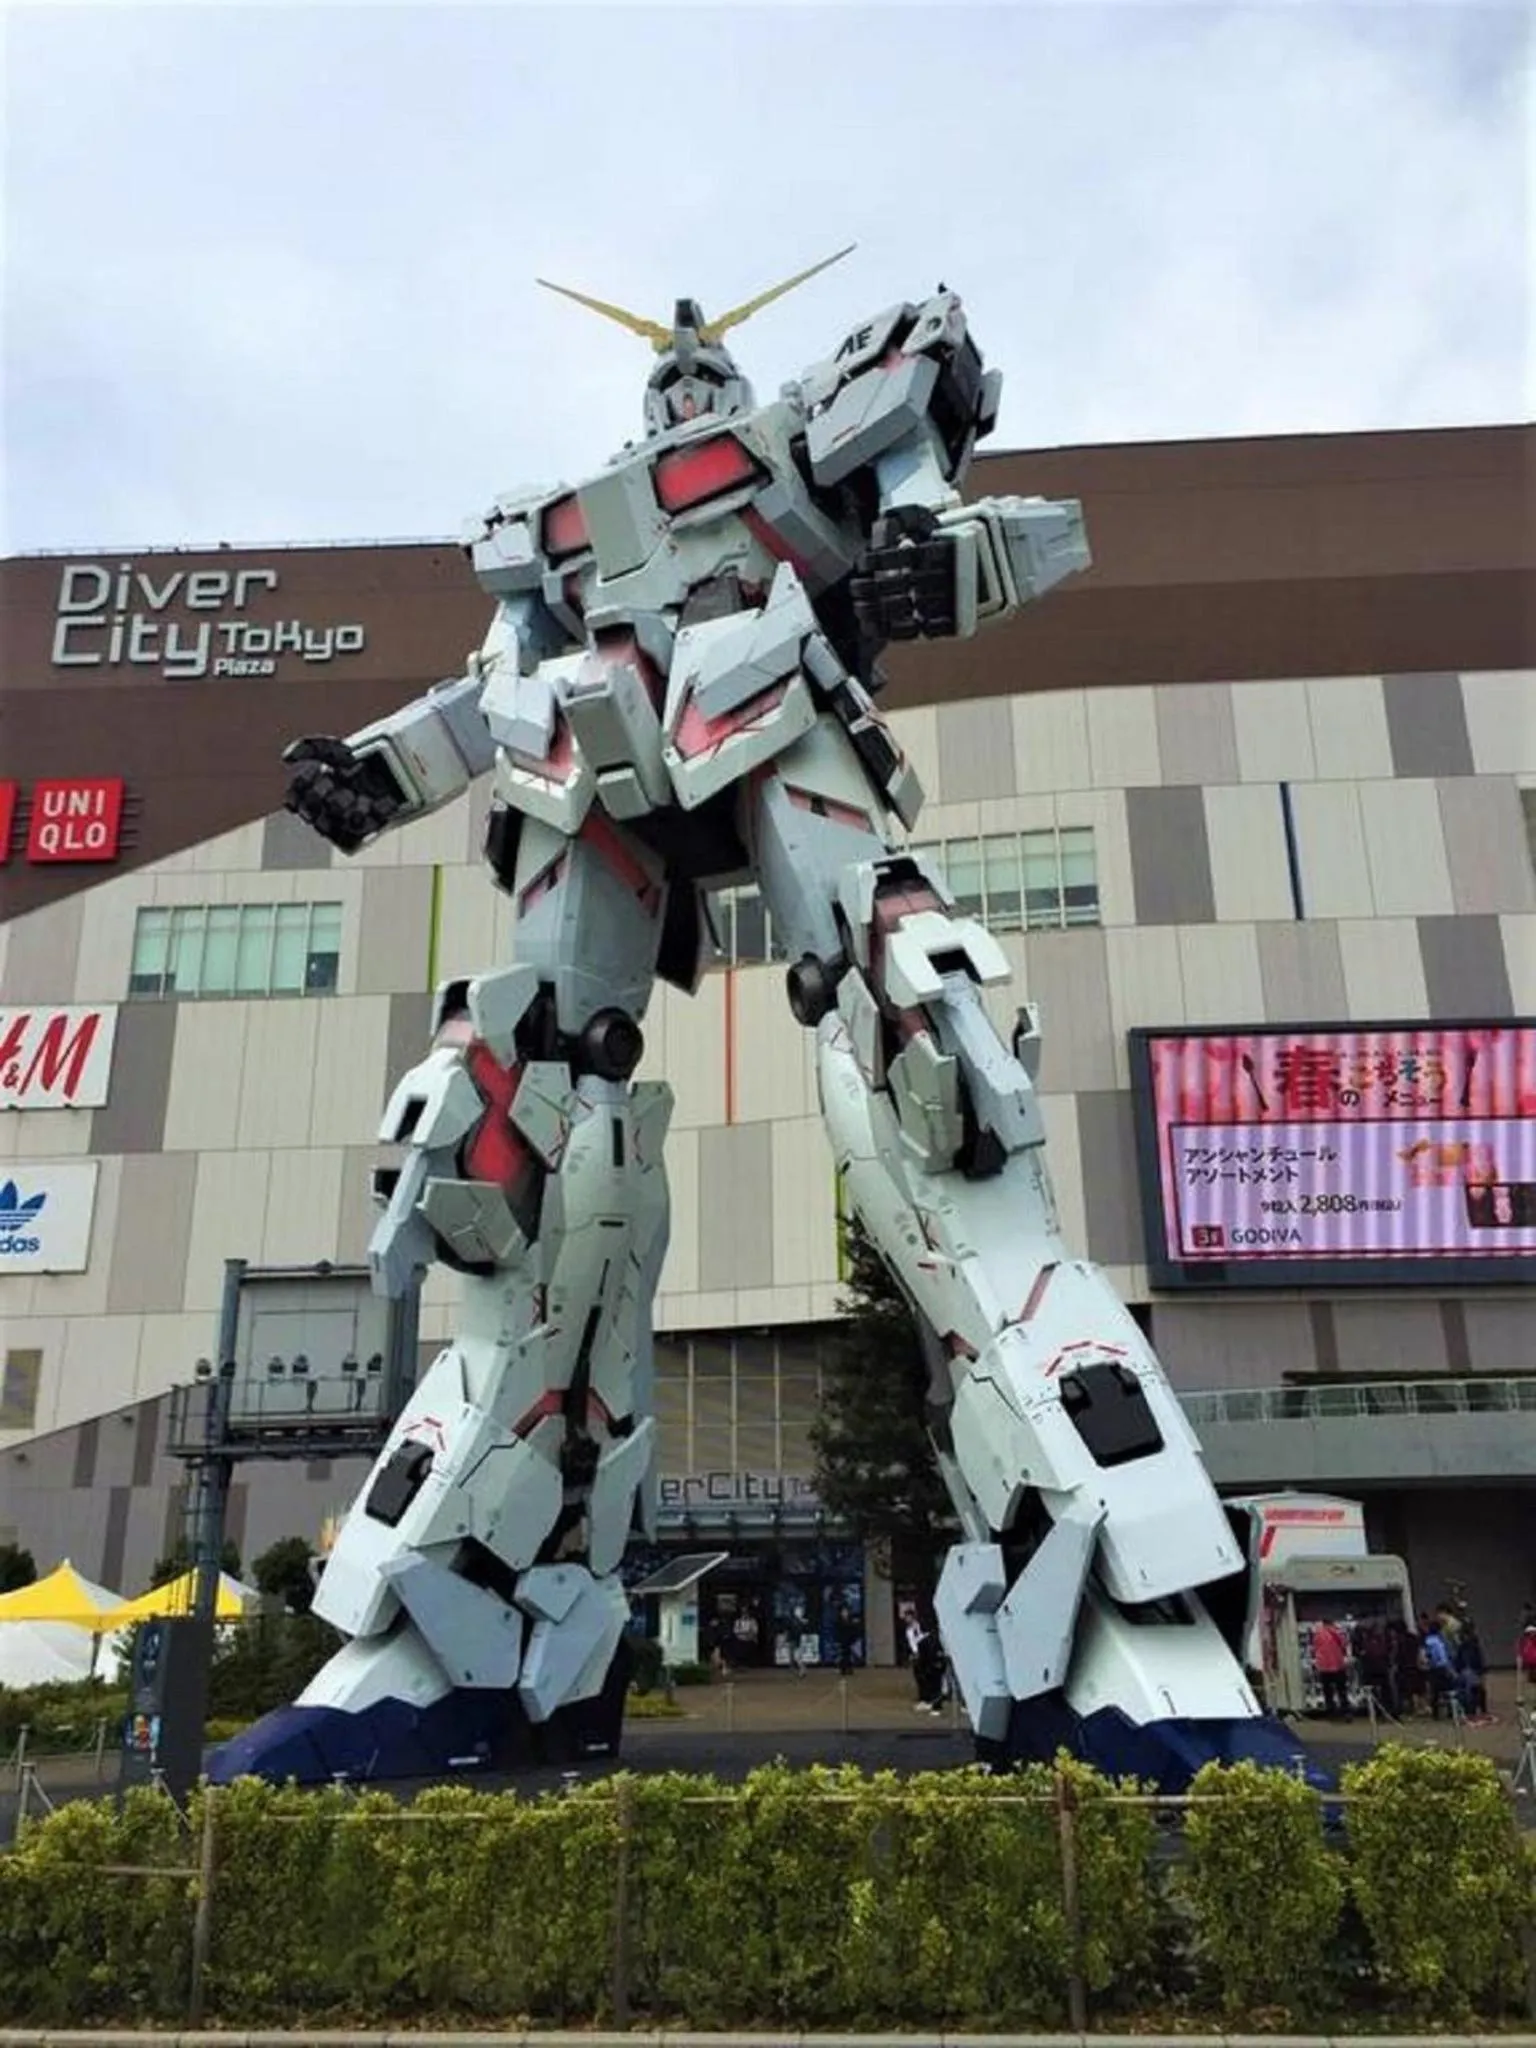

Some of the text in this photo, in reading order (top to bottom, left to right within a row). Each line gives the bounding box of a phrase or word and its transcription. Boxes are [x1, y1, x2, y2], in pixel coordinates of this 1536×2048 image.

[58, 563, 278, 614] Diver
[52, 613, 211, 679] City
[213, 657, 275, 676] Plaza
[43, 790, 106, 816] UNI
[38, 823, 107, 852] QLO
[1185, 1165, 1299, 1184] アソートメント
[1231, 1228, 1302, 1245] GODIVA
